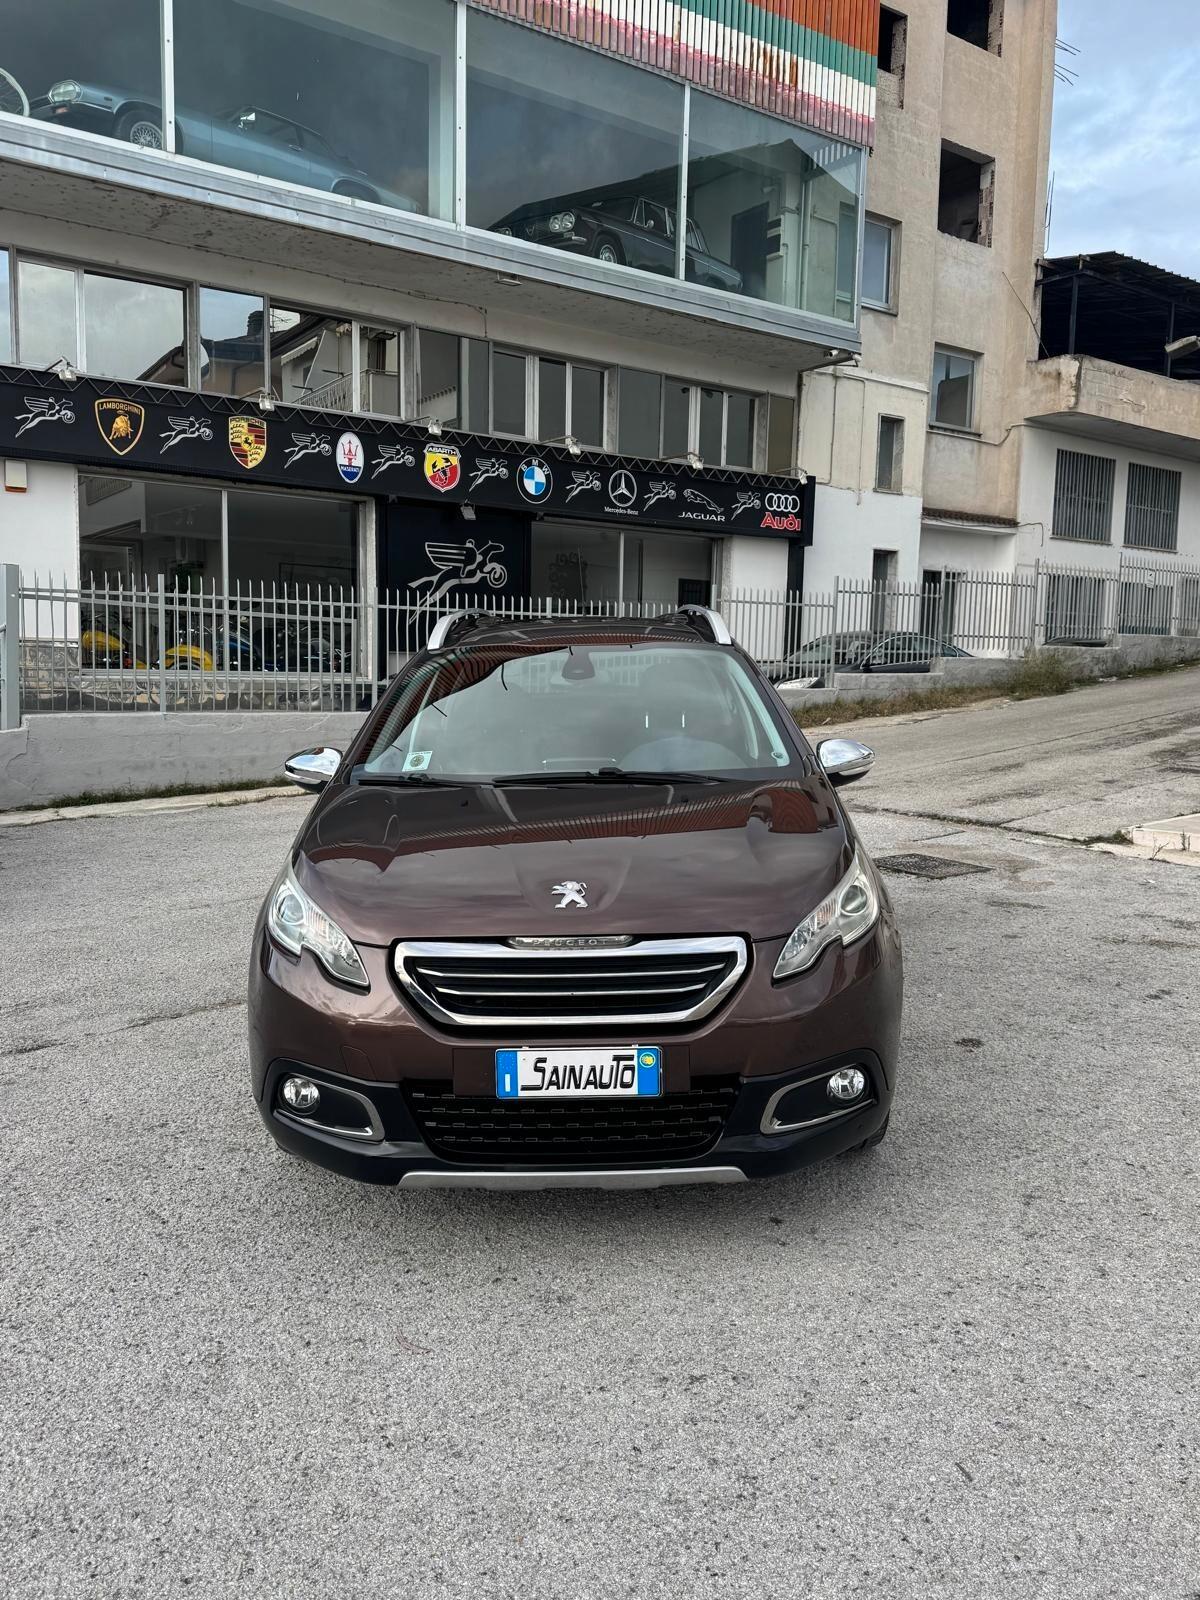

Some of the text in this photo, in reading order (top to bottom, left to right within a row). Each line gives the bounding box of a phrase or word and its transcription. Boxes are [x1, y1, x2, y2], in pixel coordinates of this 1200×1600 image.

[428, 447, 457, 455] ABARTH
[604, 506, 639, 516] Mercedes-Benz
[678, 511, 725, 522] JAGUAR
[760, 511, 801, 531] Audi
